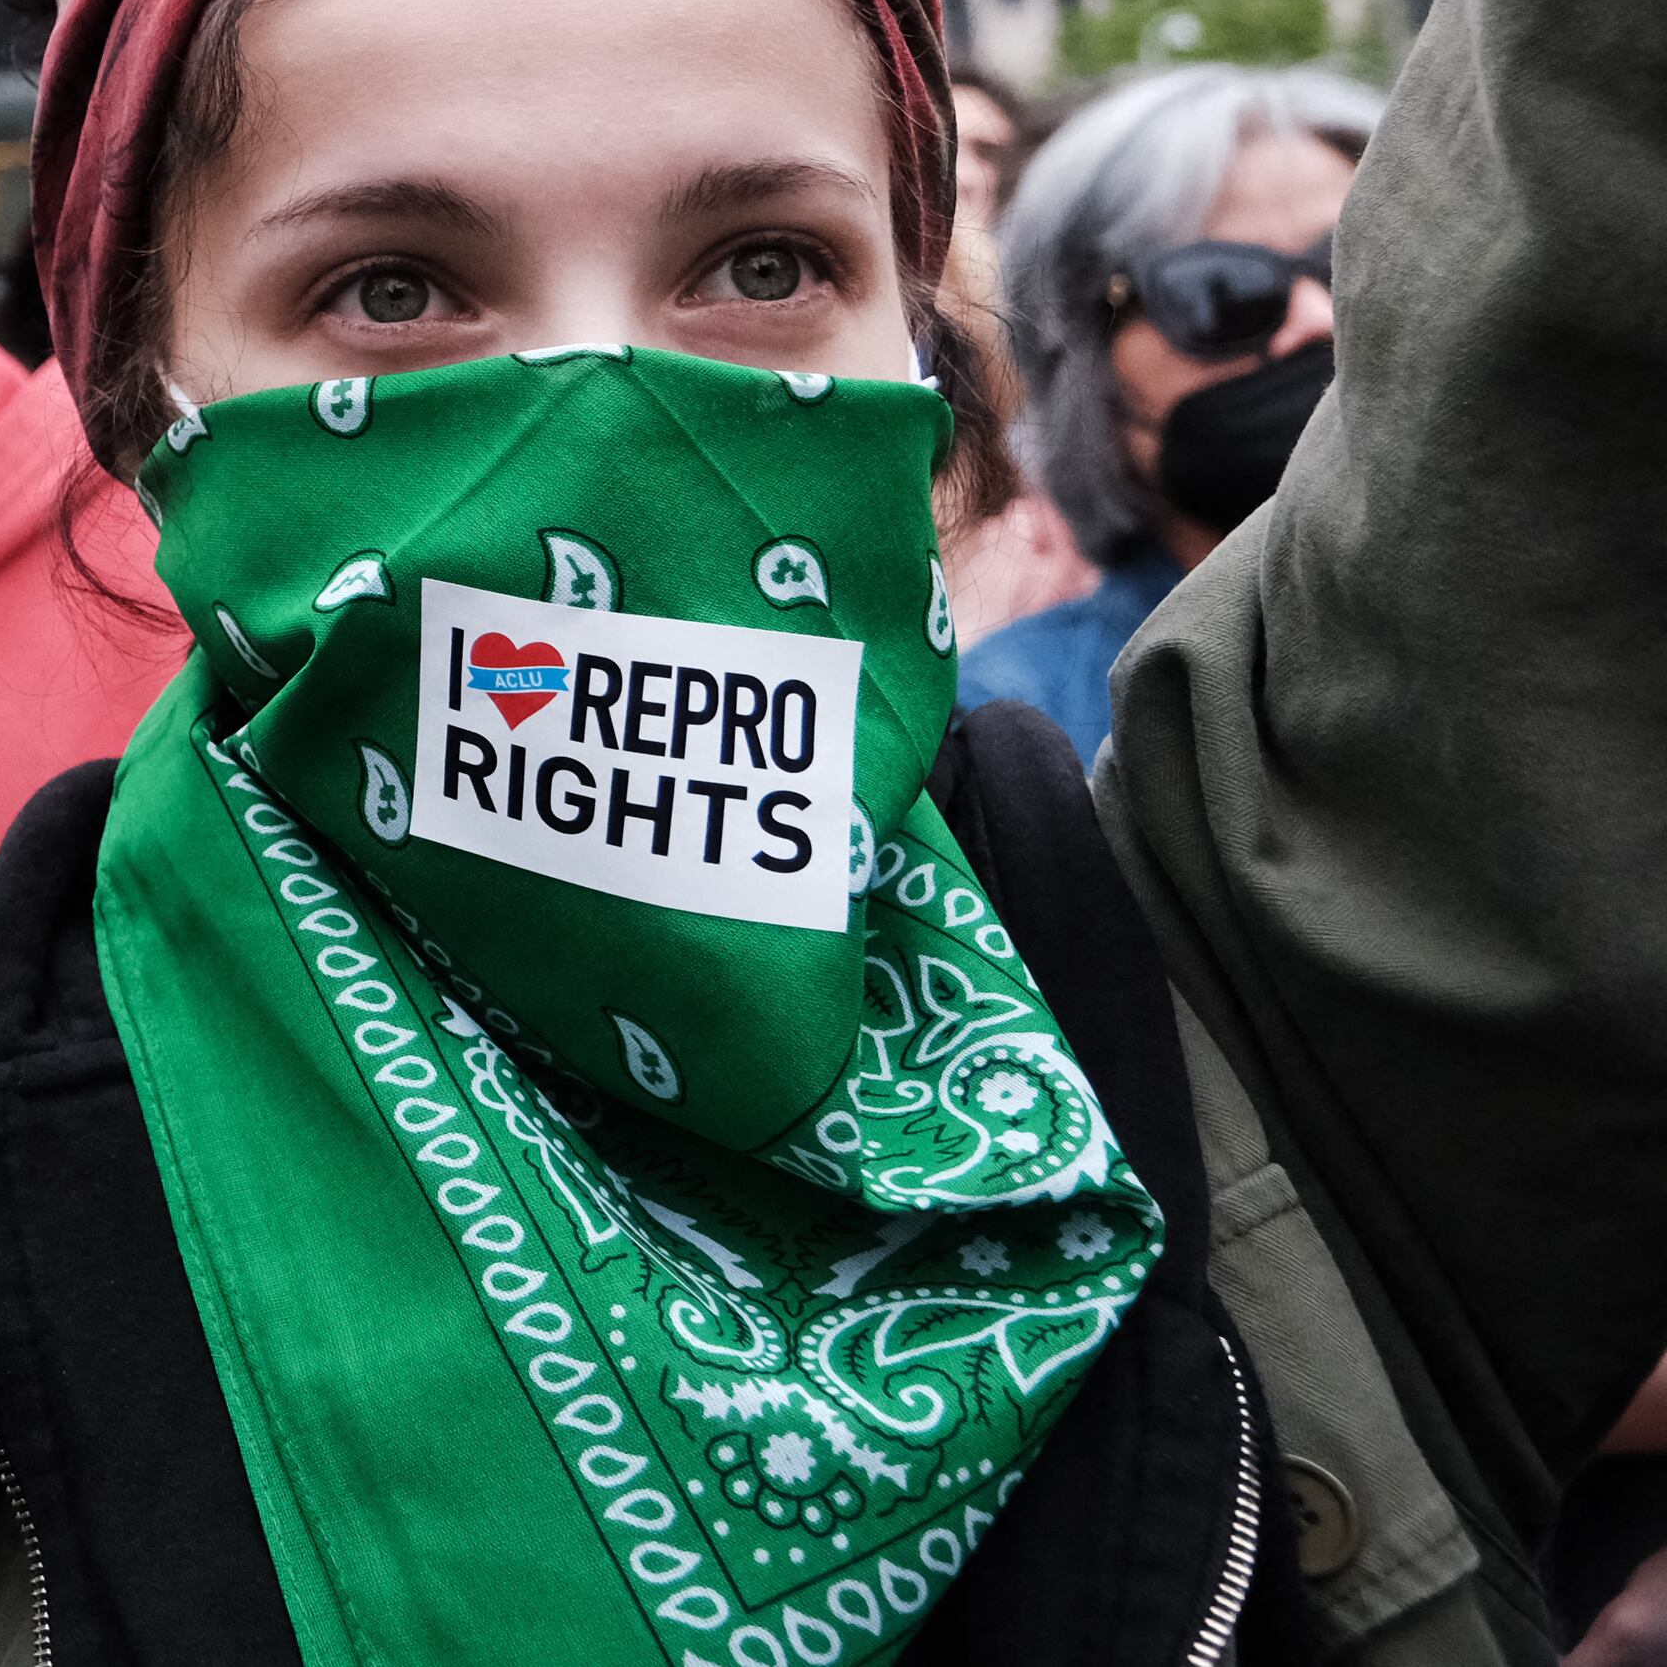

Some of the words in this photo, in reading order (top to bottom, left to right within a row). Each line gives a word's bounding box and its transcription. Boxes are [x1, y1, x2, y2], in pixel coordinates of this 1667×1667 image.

[448, 627, 464, 712] I
[570, 652, 817, 774] REPRO
[495, 671, 543, 689] ACLU
[443, 724, 813, 874] RIGHTS
